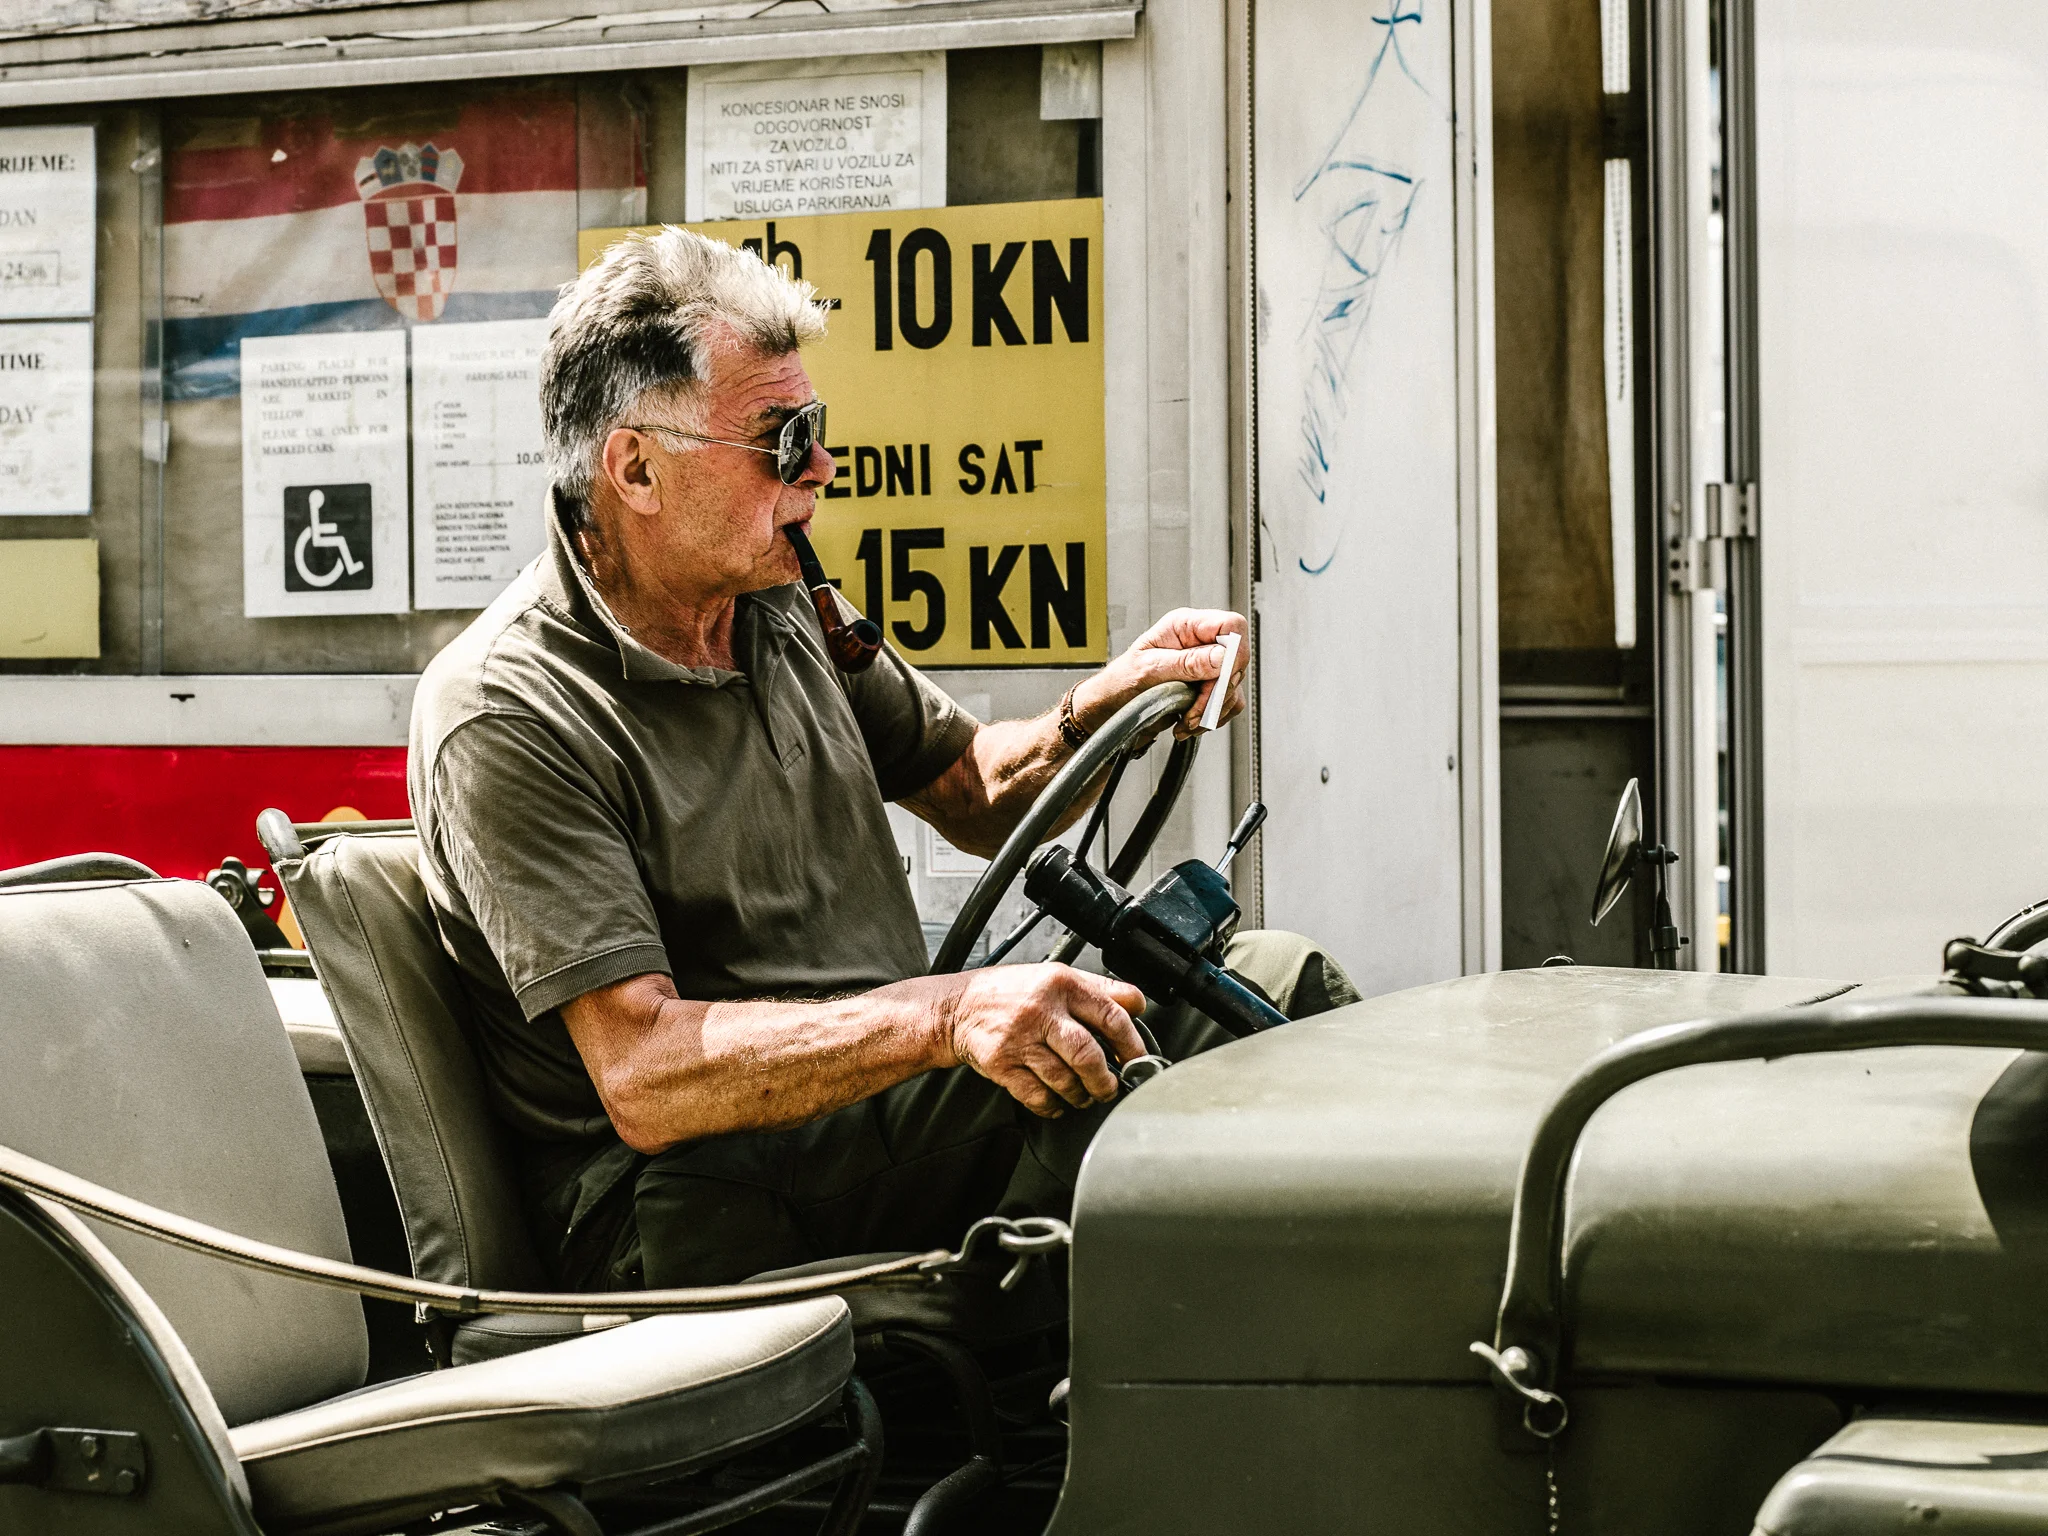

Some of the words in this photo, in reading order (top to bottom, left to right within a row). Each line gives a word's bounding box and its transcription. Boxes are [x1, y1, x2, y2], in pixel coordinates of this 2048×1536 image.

[721, 98, 829, 117] KONCESIONAR
[835, 97, 855, 110] NE
[860, 94, 905, 108] SNOSI
[754, 115, 872, 134] ODGOVORNOST
[770, 140, 789, 154] ZA
[711, 162, 738, 176] NITI
[743, 160, 761, 174] ZA
[766, 158, 818, 172] STVARI
[824, 158, 833, 170] U
[838, 155, 890, 169] VOZILU
[895, 153, 914, 166] ZA
[732, 178, 794, 194] VRIJEME
[800, 174, 892, 190] KORIŠTENJA
[734, 198, 793, 214] USLUGA
[798, 194, 892, 210] PARKIRANJA
[865, 227, 952, 351] 10
[972, 238, 1090, 347] KN
[817, 443, 931, 499] EDNI
[958, 440, 1043, 496] SAT
[855, 527, 946, 652] 15
[969, 541, 1088, 651] KN
